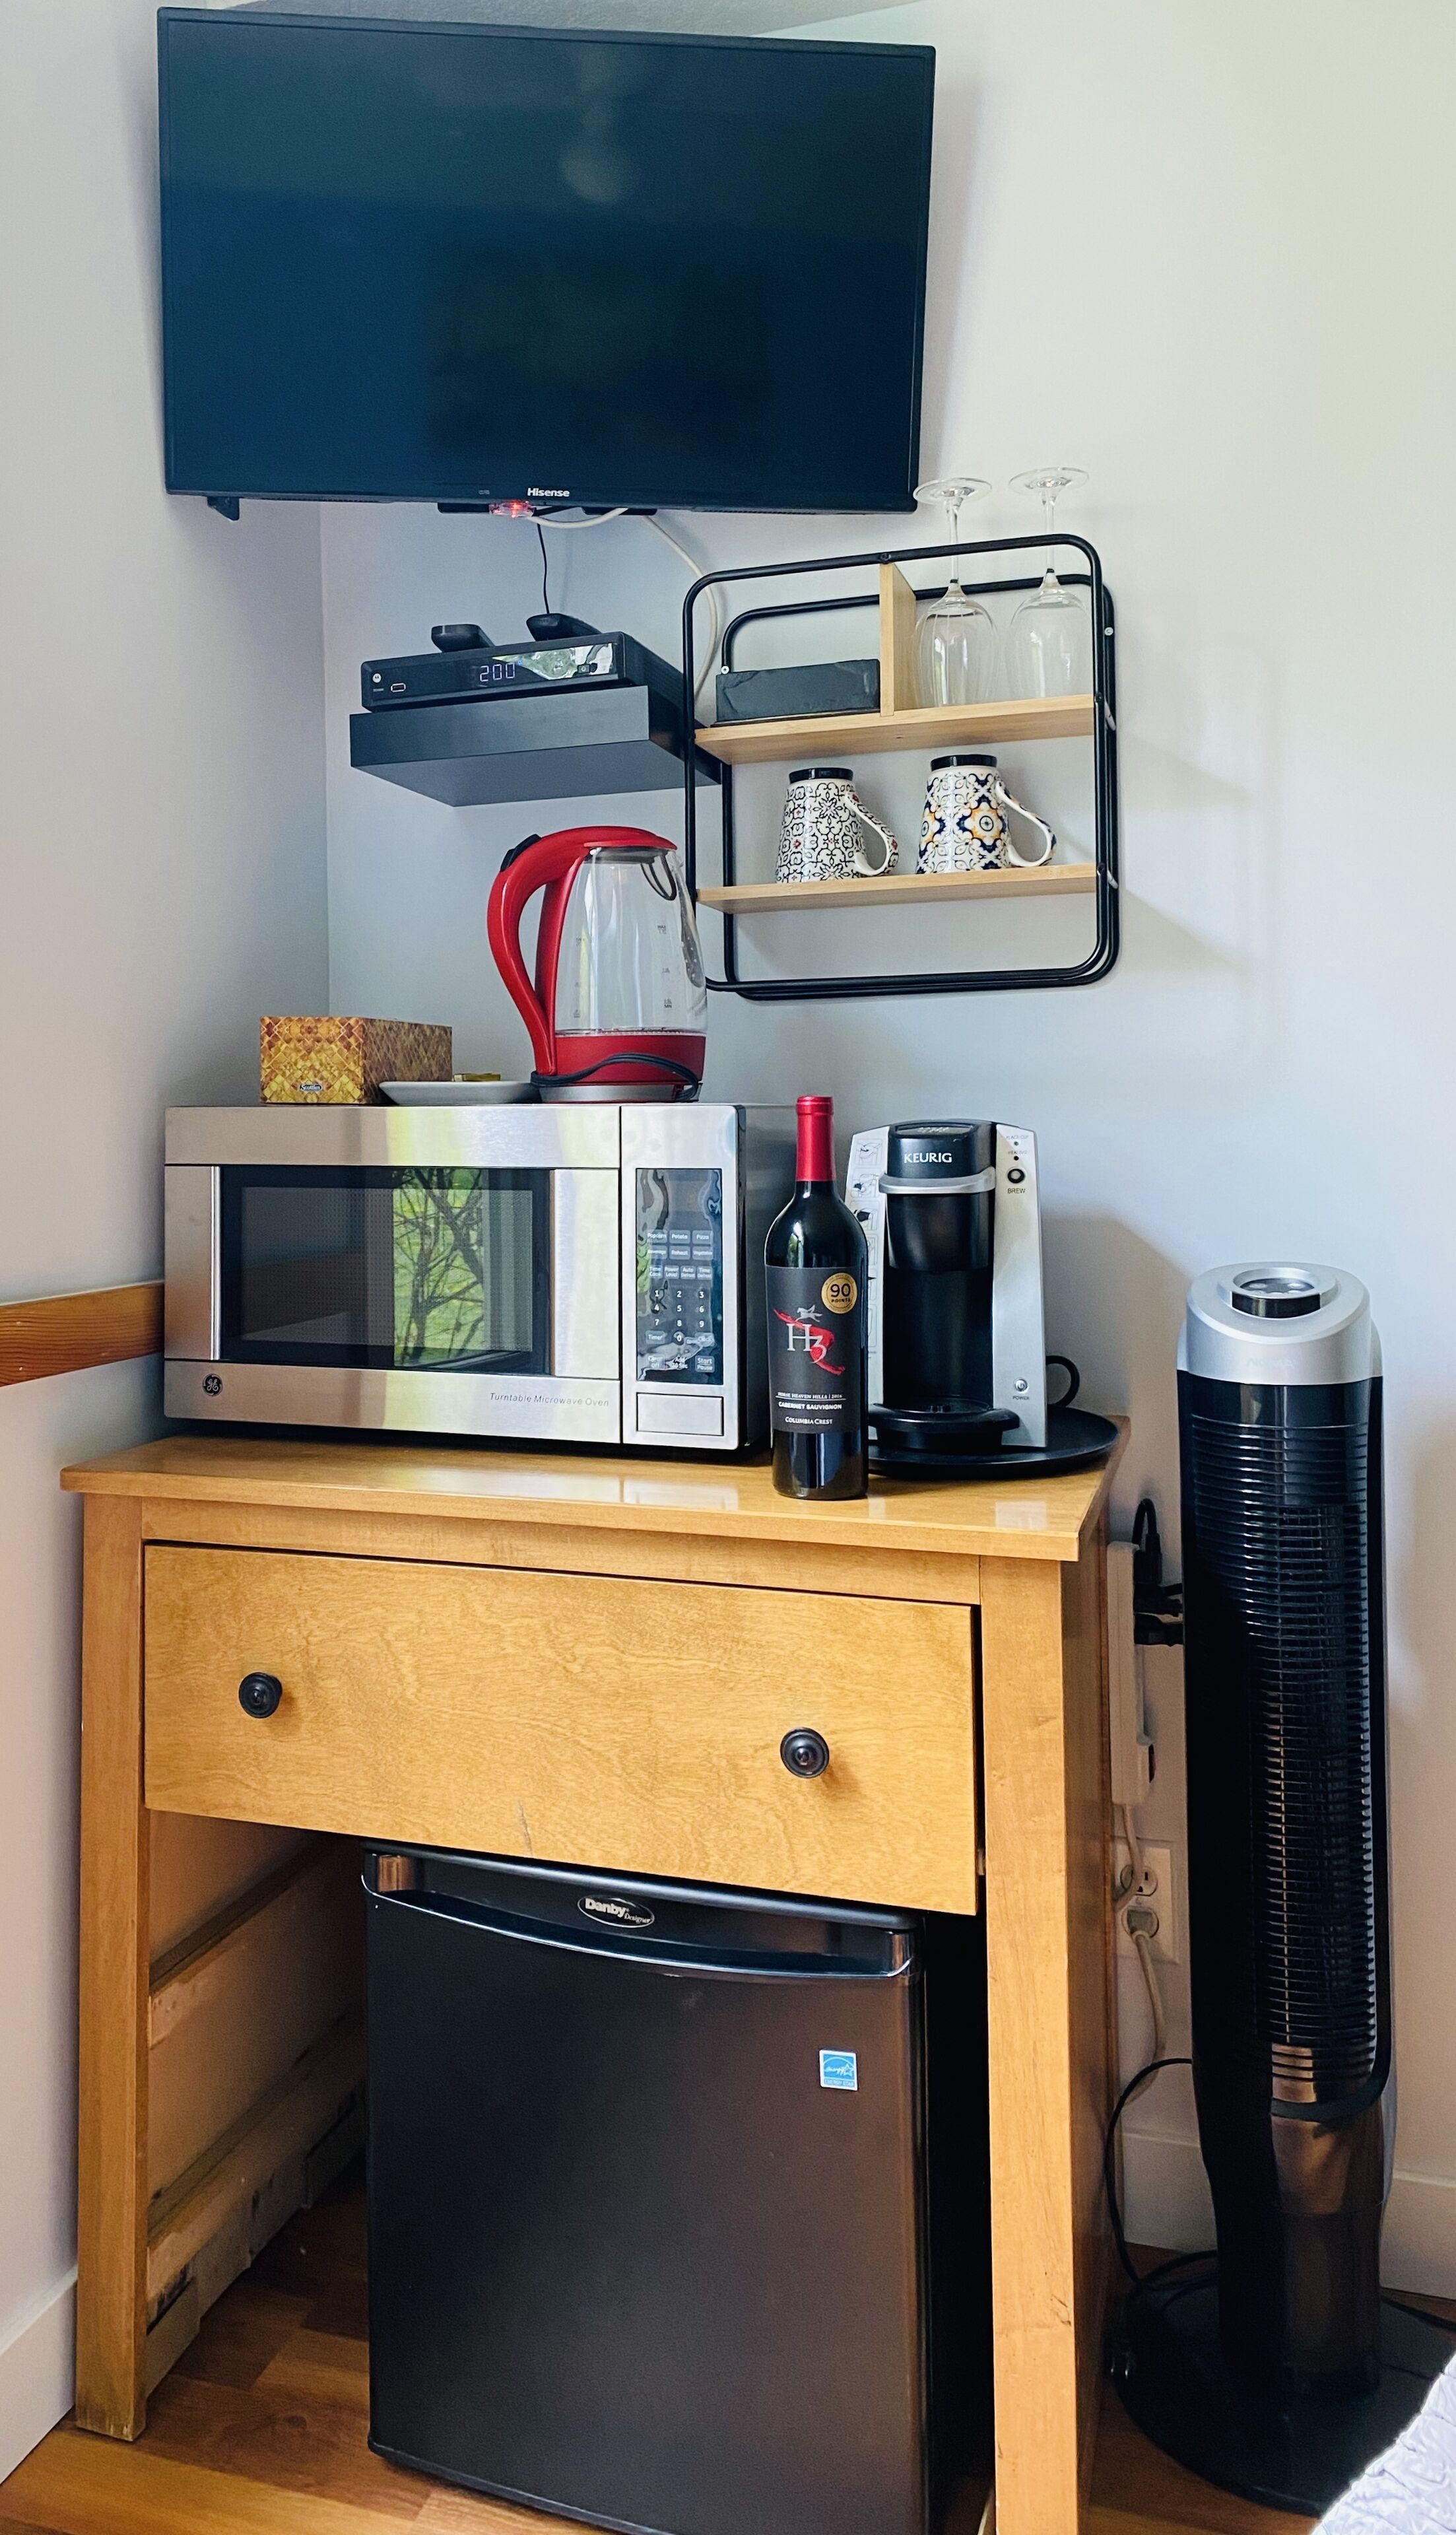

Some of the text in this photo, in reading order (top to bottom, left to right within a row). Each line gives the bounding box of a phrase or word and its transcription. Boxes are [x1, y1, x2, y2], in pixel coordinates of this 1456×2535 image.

[527, 488, 570, 497] Hisense
[479, 662, 515, 682] 200
[904, 1153, 952, 1164] KEURIG
[830, 1283, 851, 1297] 90
[490, 1392, 609, 1407] Turntable Microwave Oven
[778, 1401, 805, 1409] CABERNET
[624, 1912, 651, 1924] Designer
